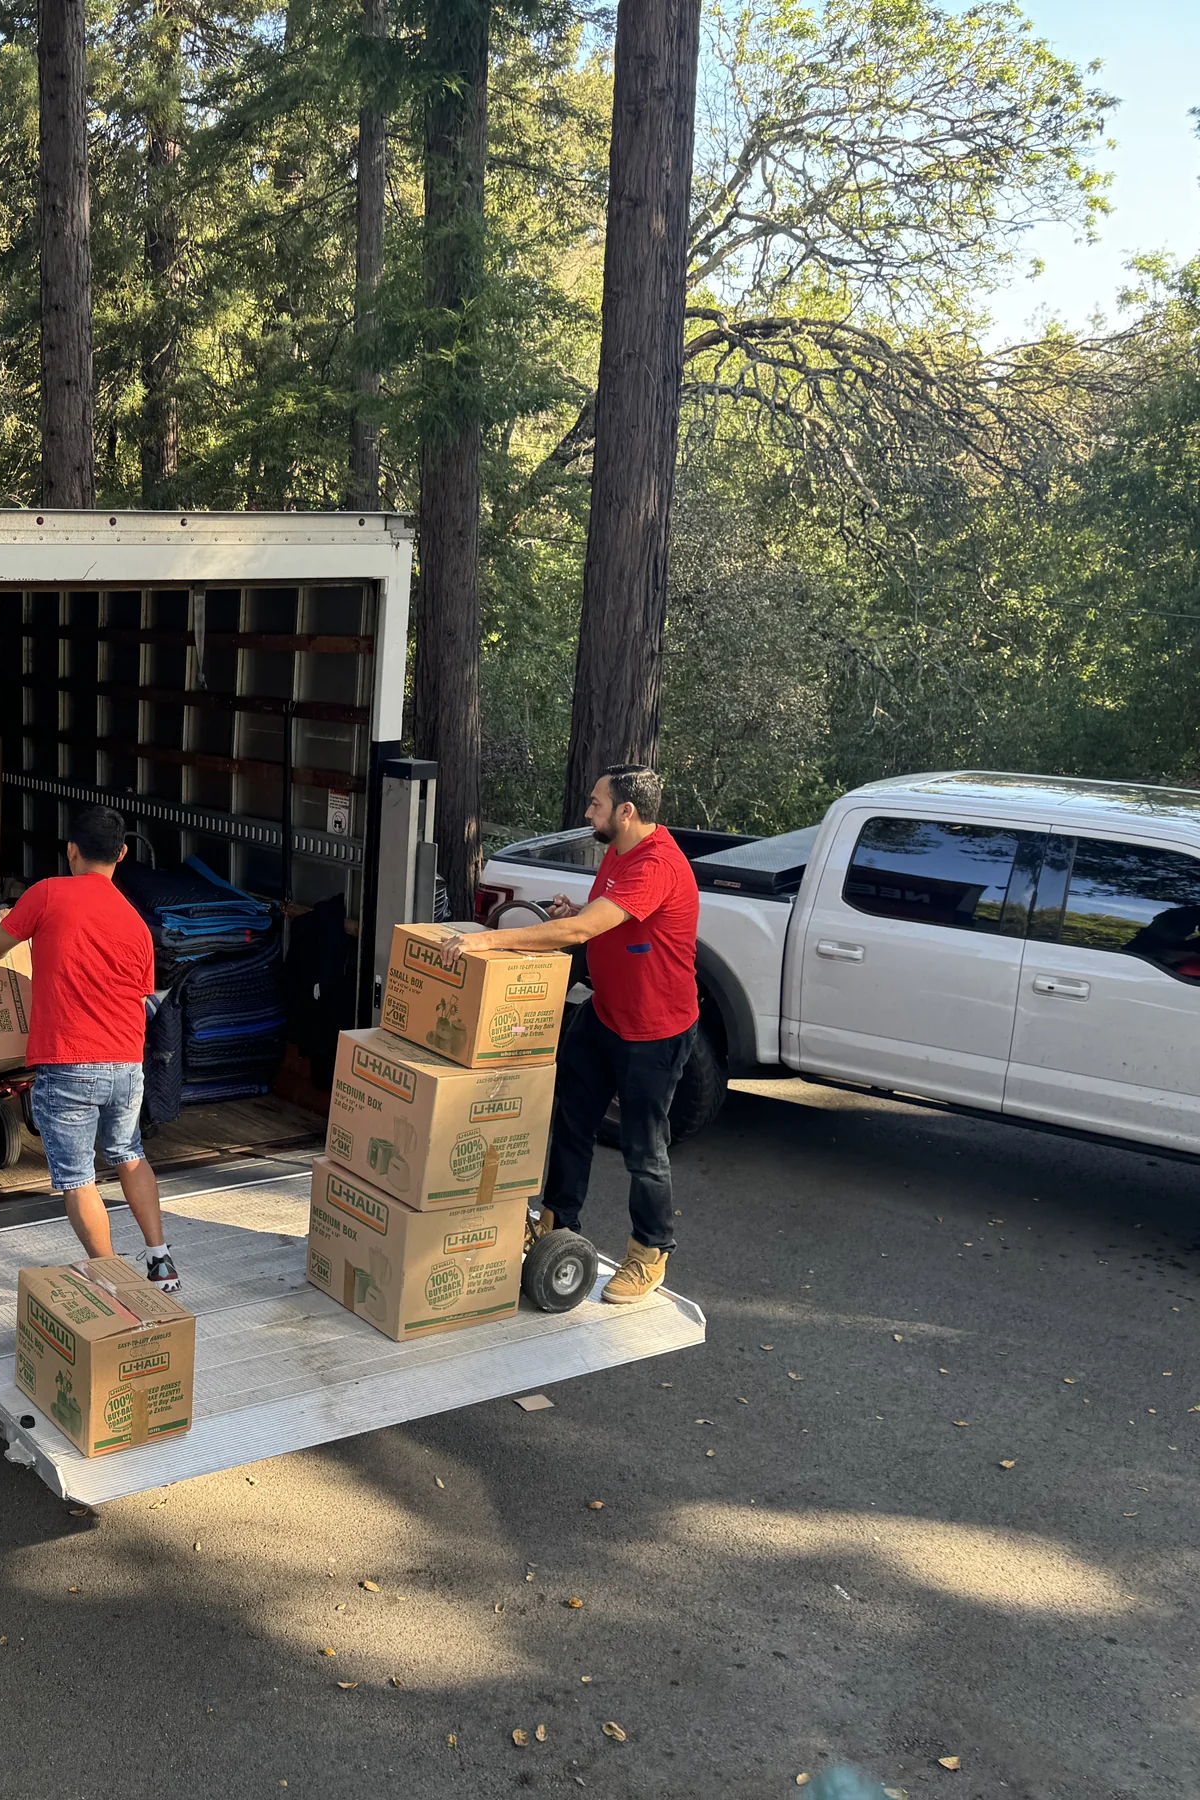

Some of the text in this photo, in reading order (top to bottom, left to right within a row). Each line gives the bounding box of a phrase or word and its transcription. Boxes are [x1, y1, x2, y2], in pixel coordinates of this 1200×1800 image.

[390, 968, 409, 983] SMALL
[411, 977, 424, 990] BOX
[509, 985, 545, 995] U-HAUL
[393, 1010, 405, 1024] OK
[494, 1012, 516, 1026] 100%
[357, 1051, 411, 1090] U-HAUL
[336, 1079, 365, 1103] MEDIUM
[368, 1095, 383, 1112] BOX
[474, 1101, 519, 1115] U-HAUL
[493, 1133, 530, 1144] NEED BOXES?
[507, 1141, 529, 1150] PLENTY!
[338, 1140, 350, 1153] OK
[456, 1139, 483, 1157] 100%
[505, 1151, 516, 1159] Buy
[331, 1180, 384, 1223] U-HAUL
[312, 1206, 340, 1231] MEDIUM
[343, 1224, 358, 1242] BOX
[448, 1230, 494, 1246] U-HAUL
[317, 1264, 329, 1279] OK
[469, 1260, 506, 1272] NEED BOXES?
[430, 1269, 458, 1288] 100%
[494, 1274, 508, 1283] Back
[428, 1280, 461, 1298] BUY-BACK
[477, 1286, 496, 1294] Extras.
[30, 1298, 72, 1352] U-HAUL
[123, 1355, 167, 1374] U-HAUL
[148, 1381, 181, 1394] EED BOXES?
[148, 1388, 181, 1401] AKE PLENTY!
[158, 1398, 169, 1406] Buy
[170, 1394, 184, 1403] Back
[154, 1405, 172, 1414] Extras.
